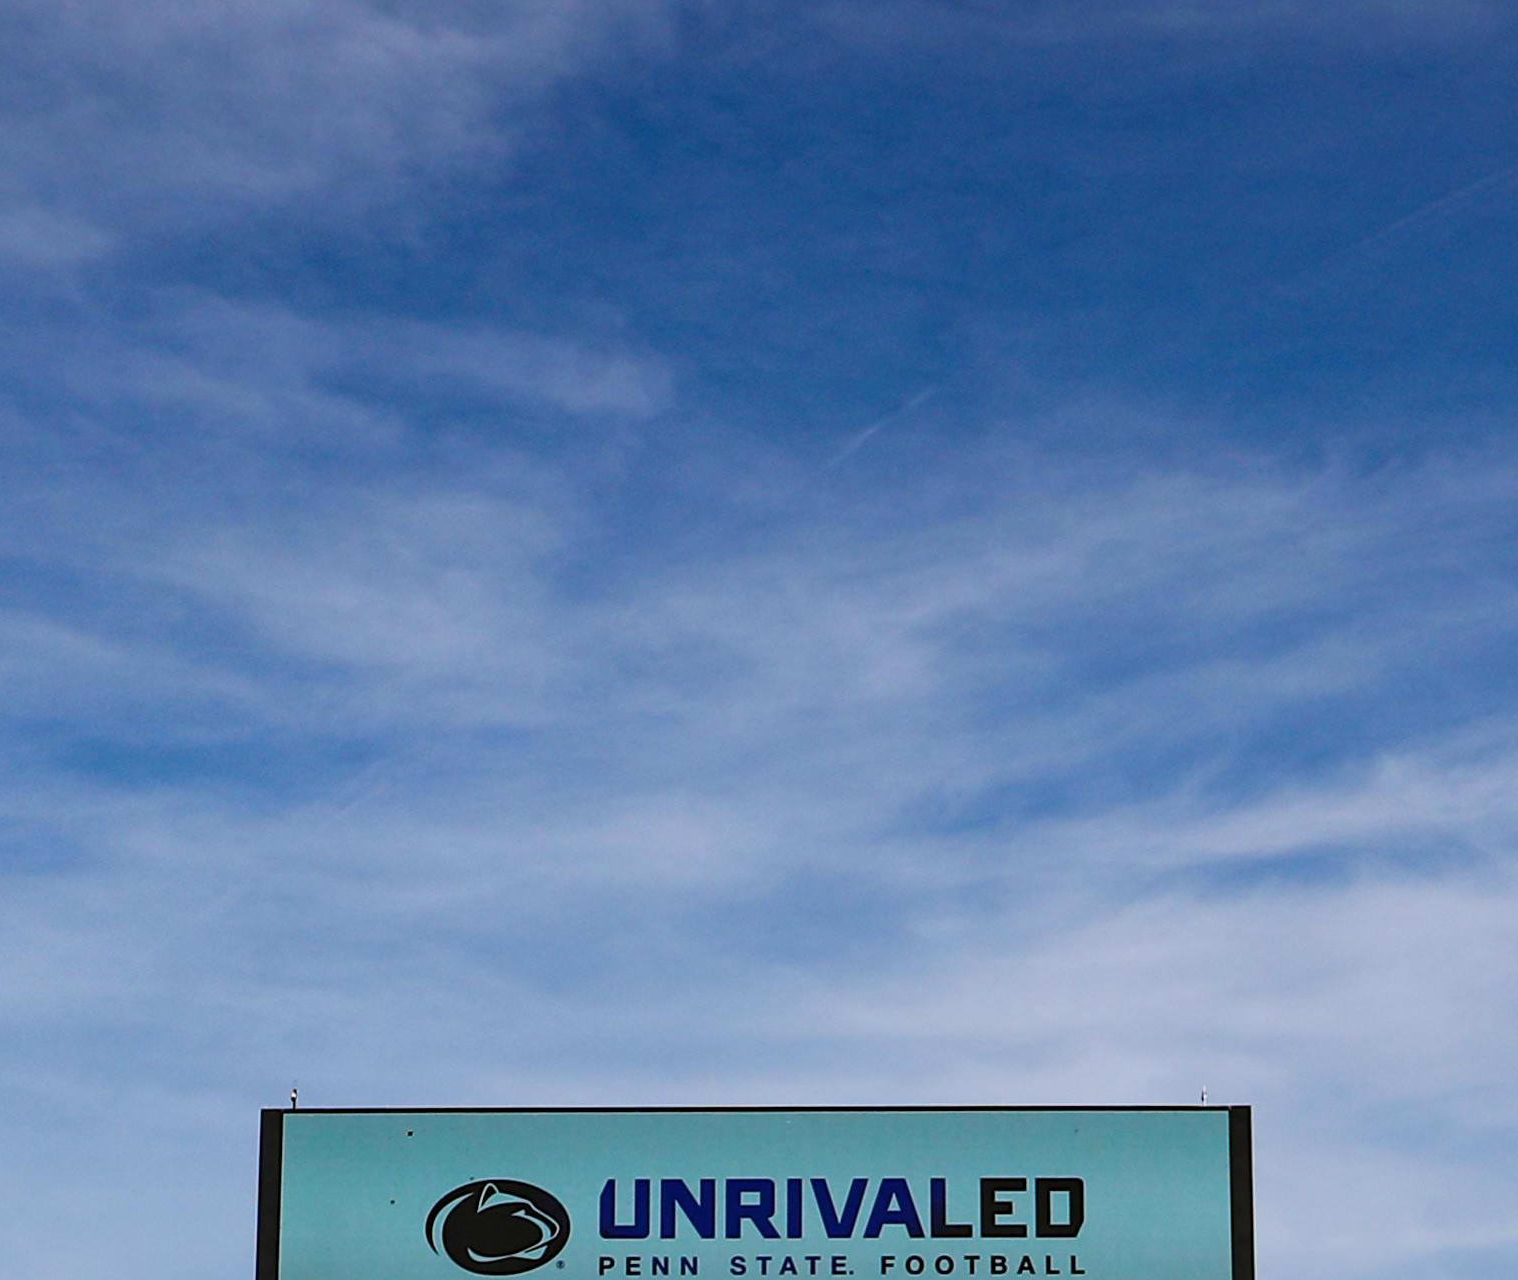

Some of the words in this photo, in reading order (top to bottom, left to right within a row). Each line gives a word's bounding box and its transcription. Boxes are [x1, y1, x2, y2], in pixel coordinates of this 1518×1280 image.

[599, 1177, 1084, 1240] UNRIVALED
[598, 1256, 699, 1276] PENN
[881, 1255, 1085, 1275] FOOTBALL
